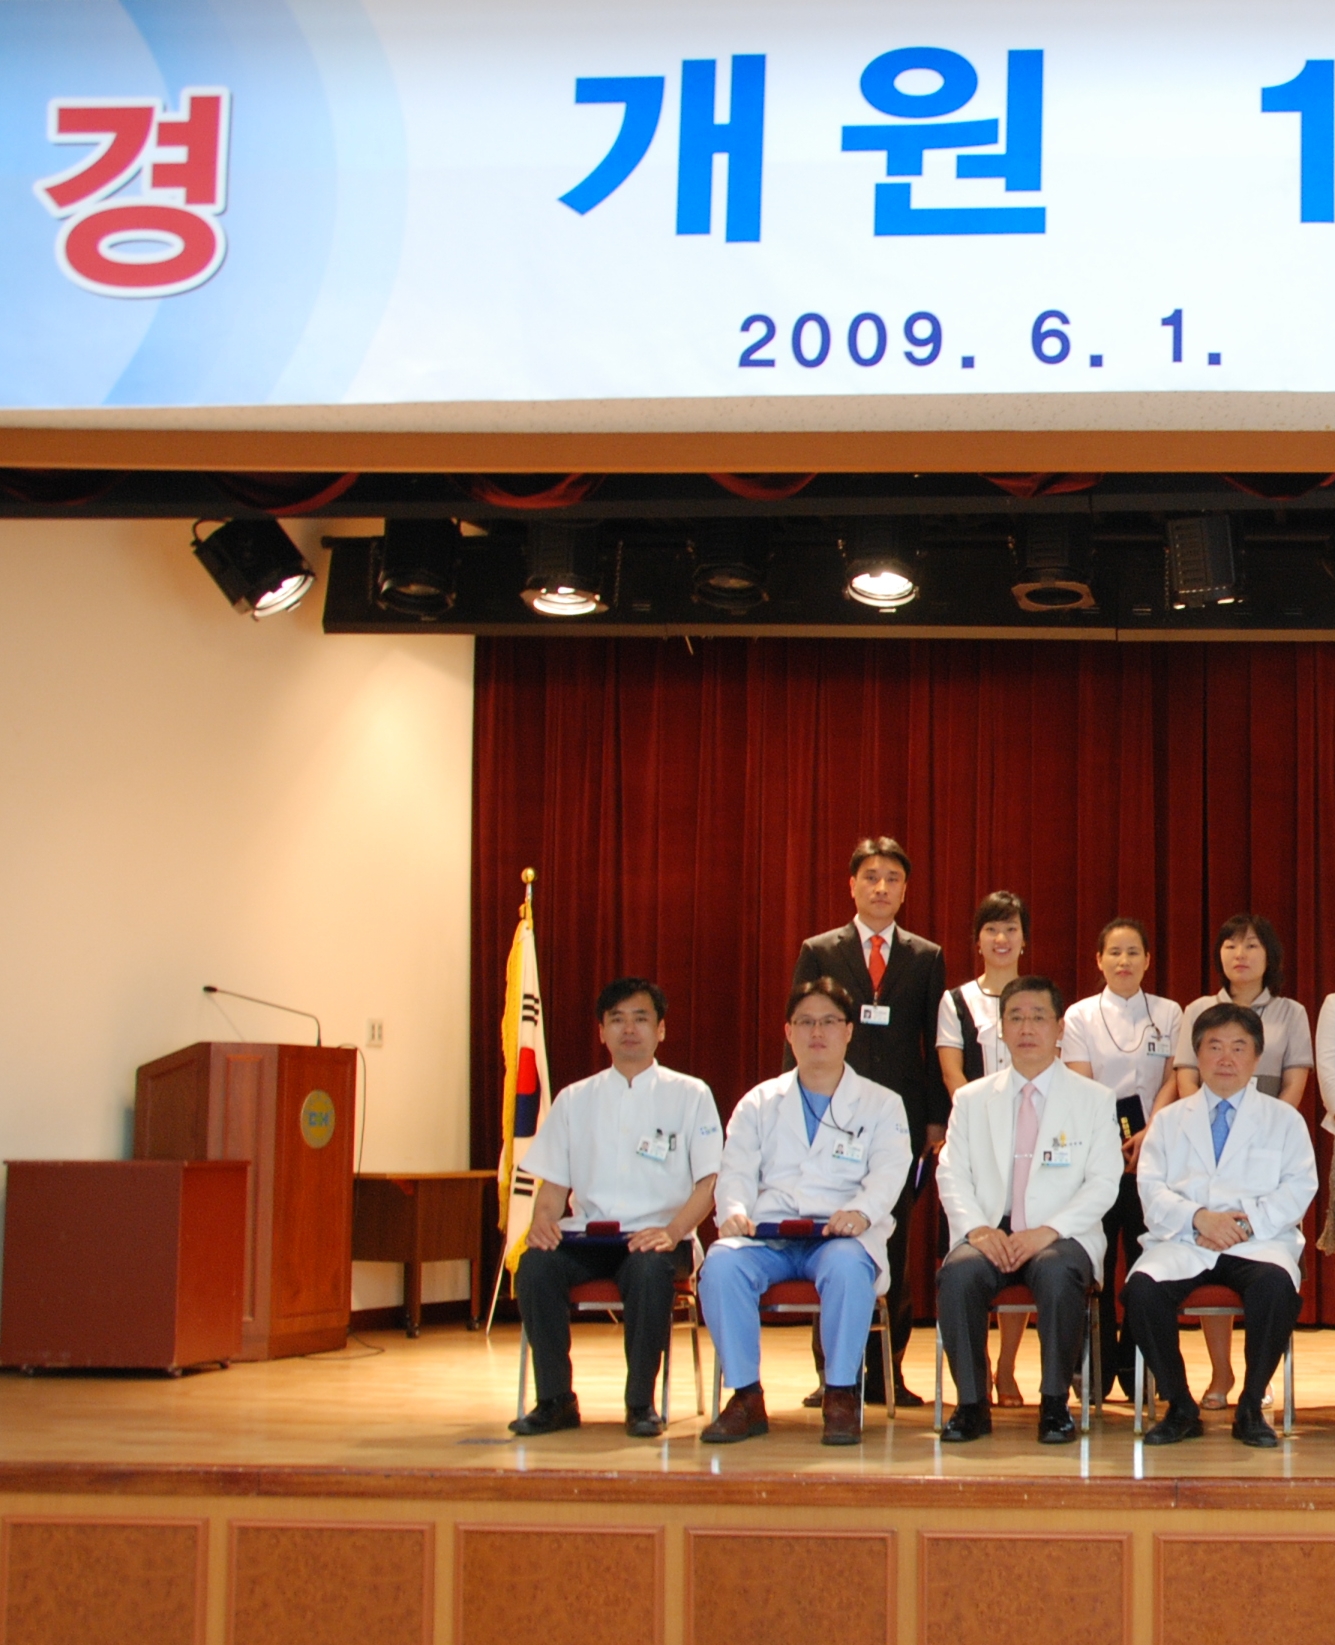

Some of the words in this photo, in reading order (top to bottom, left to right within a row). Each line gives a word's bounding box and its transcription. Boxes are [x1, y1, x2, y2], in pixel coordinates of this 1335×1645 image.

[47, 96, 219, 287] 경
[558, 46, 1046, 243] 개원
[739, 311, 976, 370] 2009.
[1031, 310, 1104, 368] 6.
[1161, 308, 1222, 366] 1.
